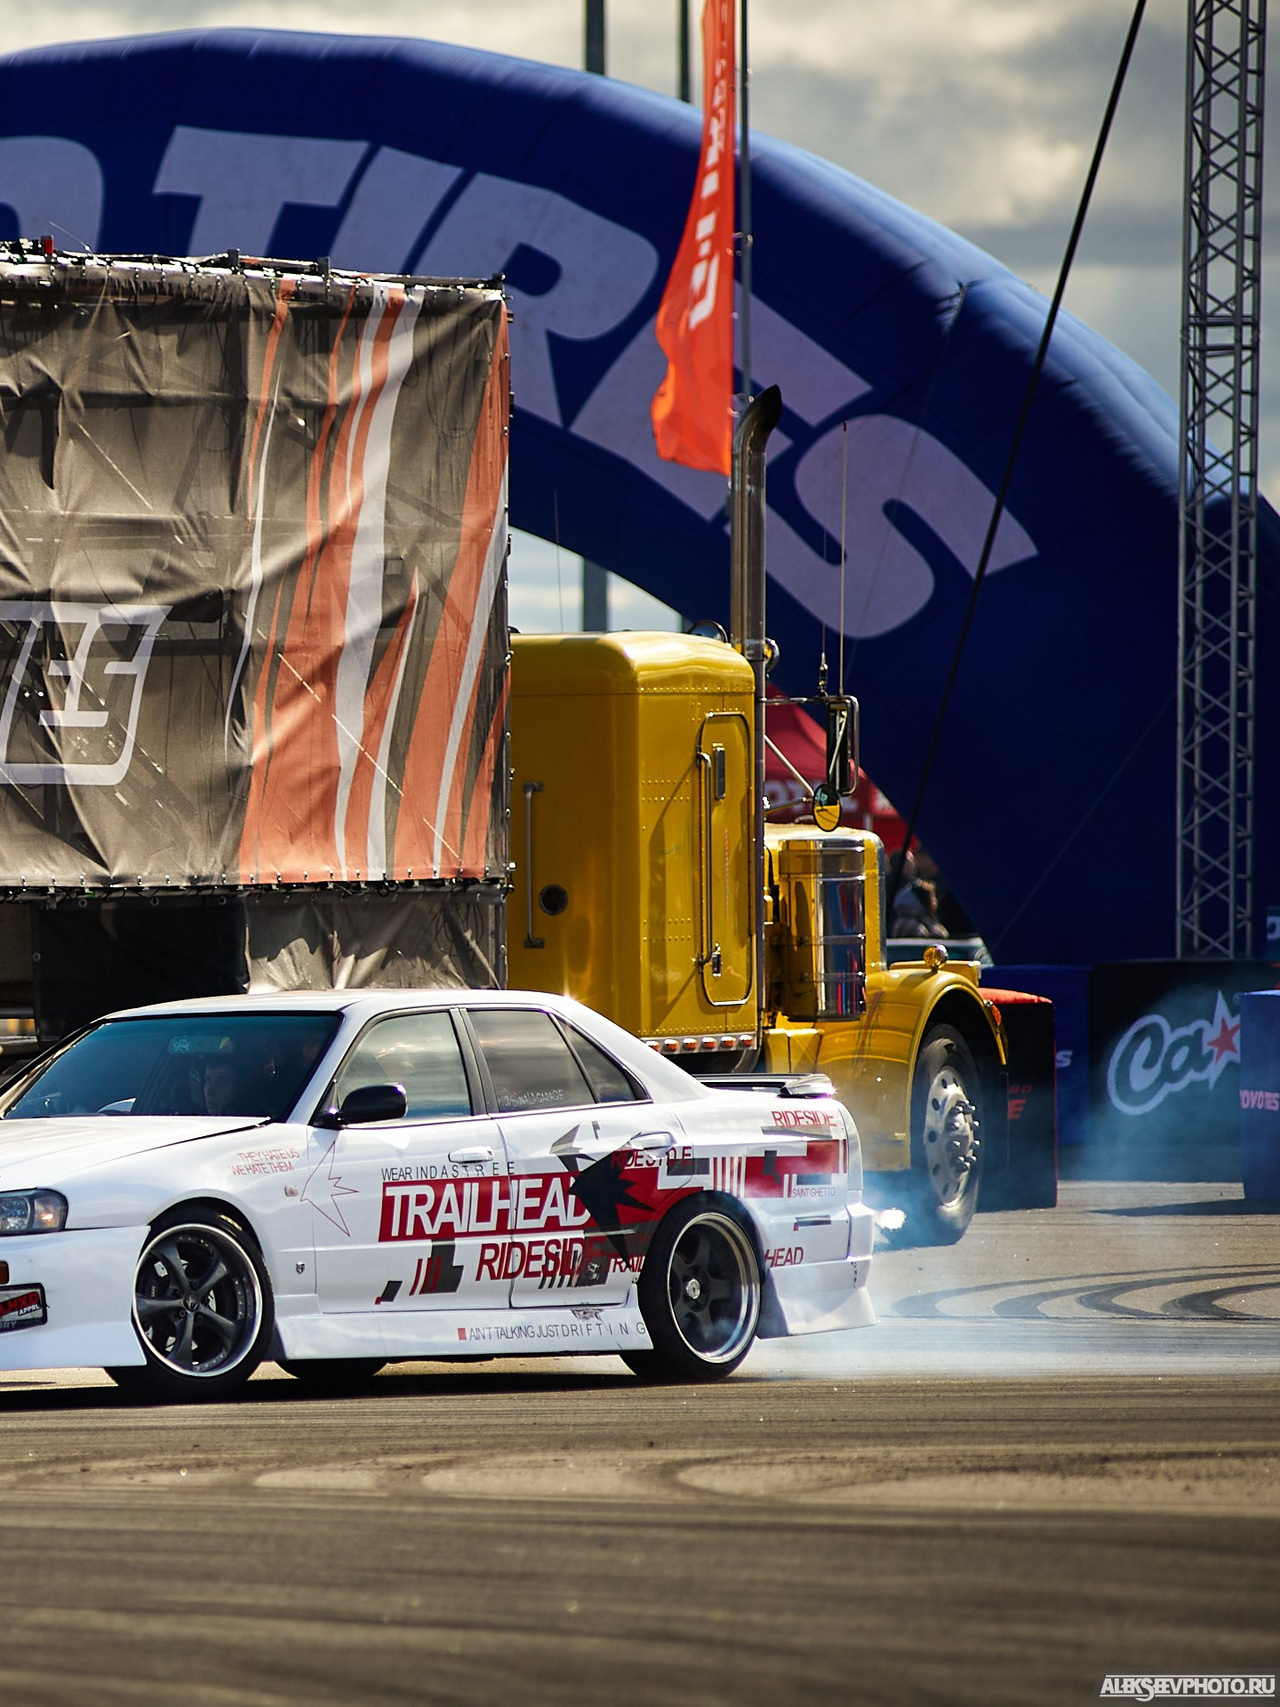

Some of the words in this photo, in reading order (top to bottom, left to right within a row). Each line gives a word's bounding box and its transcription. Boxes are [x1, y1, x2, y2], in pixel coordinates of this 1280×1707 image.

[771, 1110, 837, 1128] RIDESIDE
[263, 1149, 287, 1161] HATE
[286, 1148, 300, 1159] US
[228, 1164, 247, 1176] WE
[246, 1162, 270, 1174] HATE
[269, 1161, 294, 1173] THEM
[381, 1167, 413, 1181] WEAR
[792, 1188, 809, 1198] SAINT
[385, 1176, 591, 1238] TRAILHEAD
[493, 1325, 536, 1340] TALKING
[536, 1324, 560, 1338] JUST
[562, 1321, 646, 1337] DRIFTING
